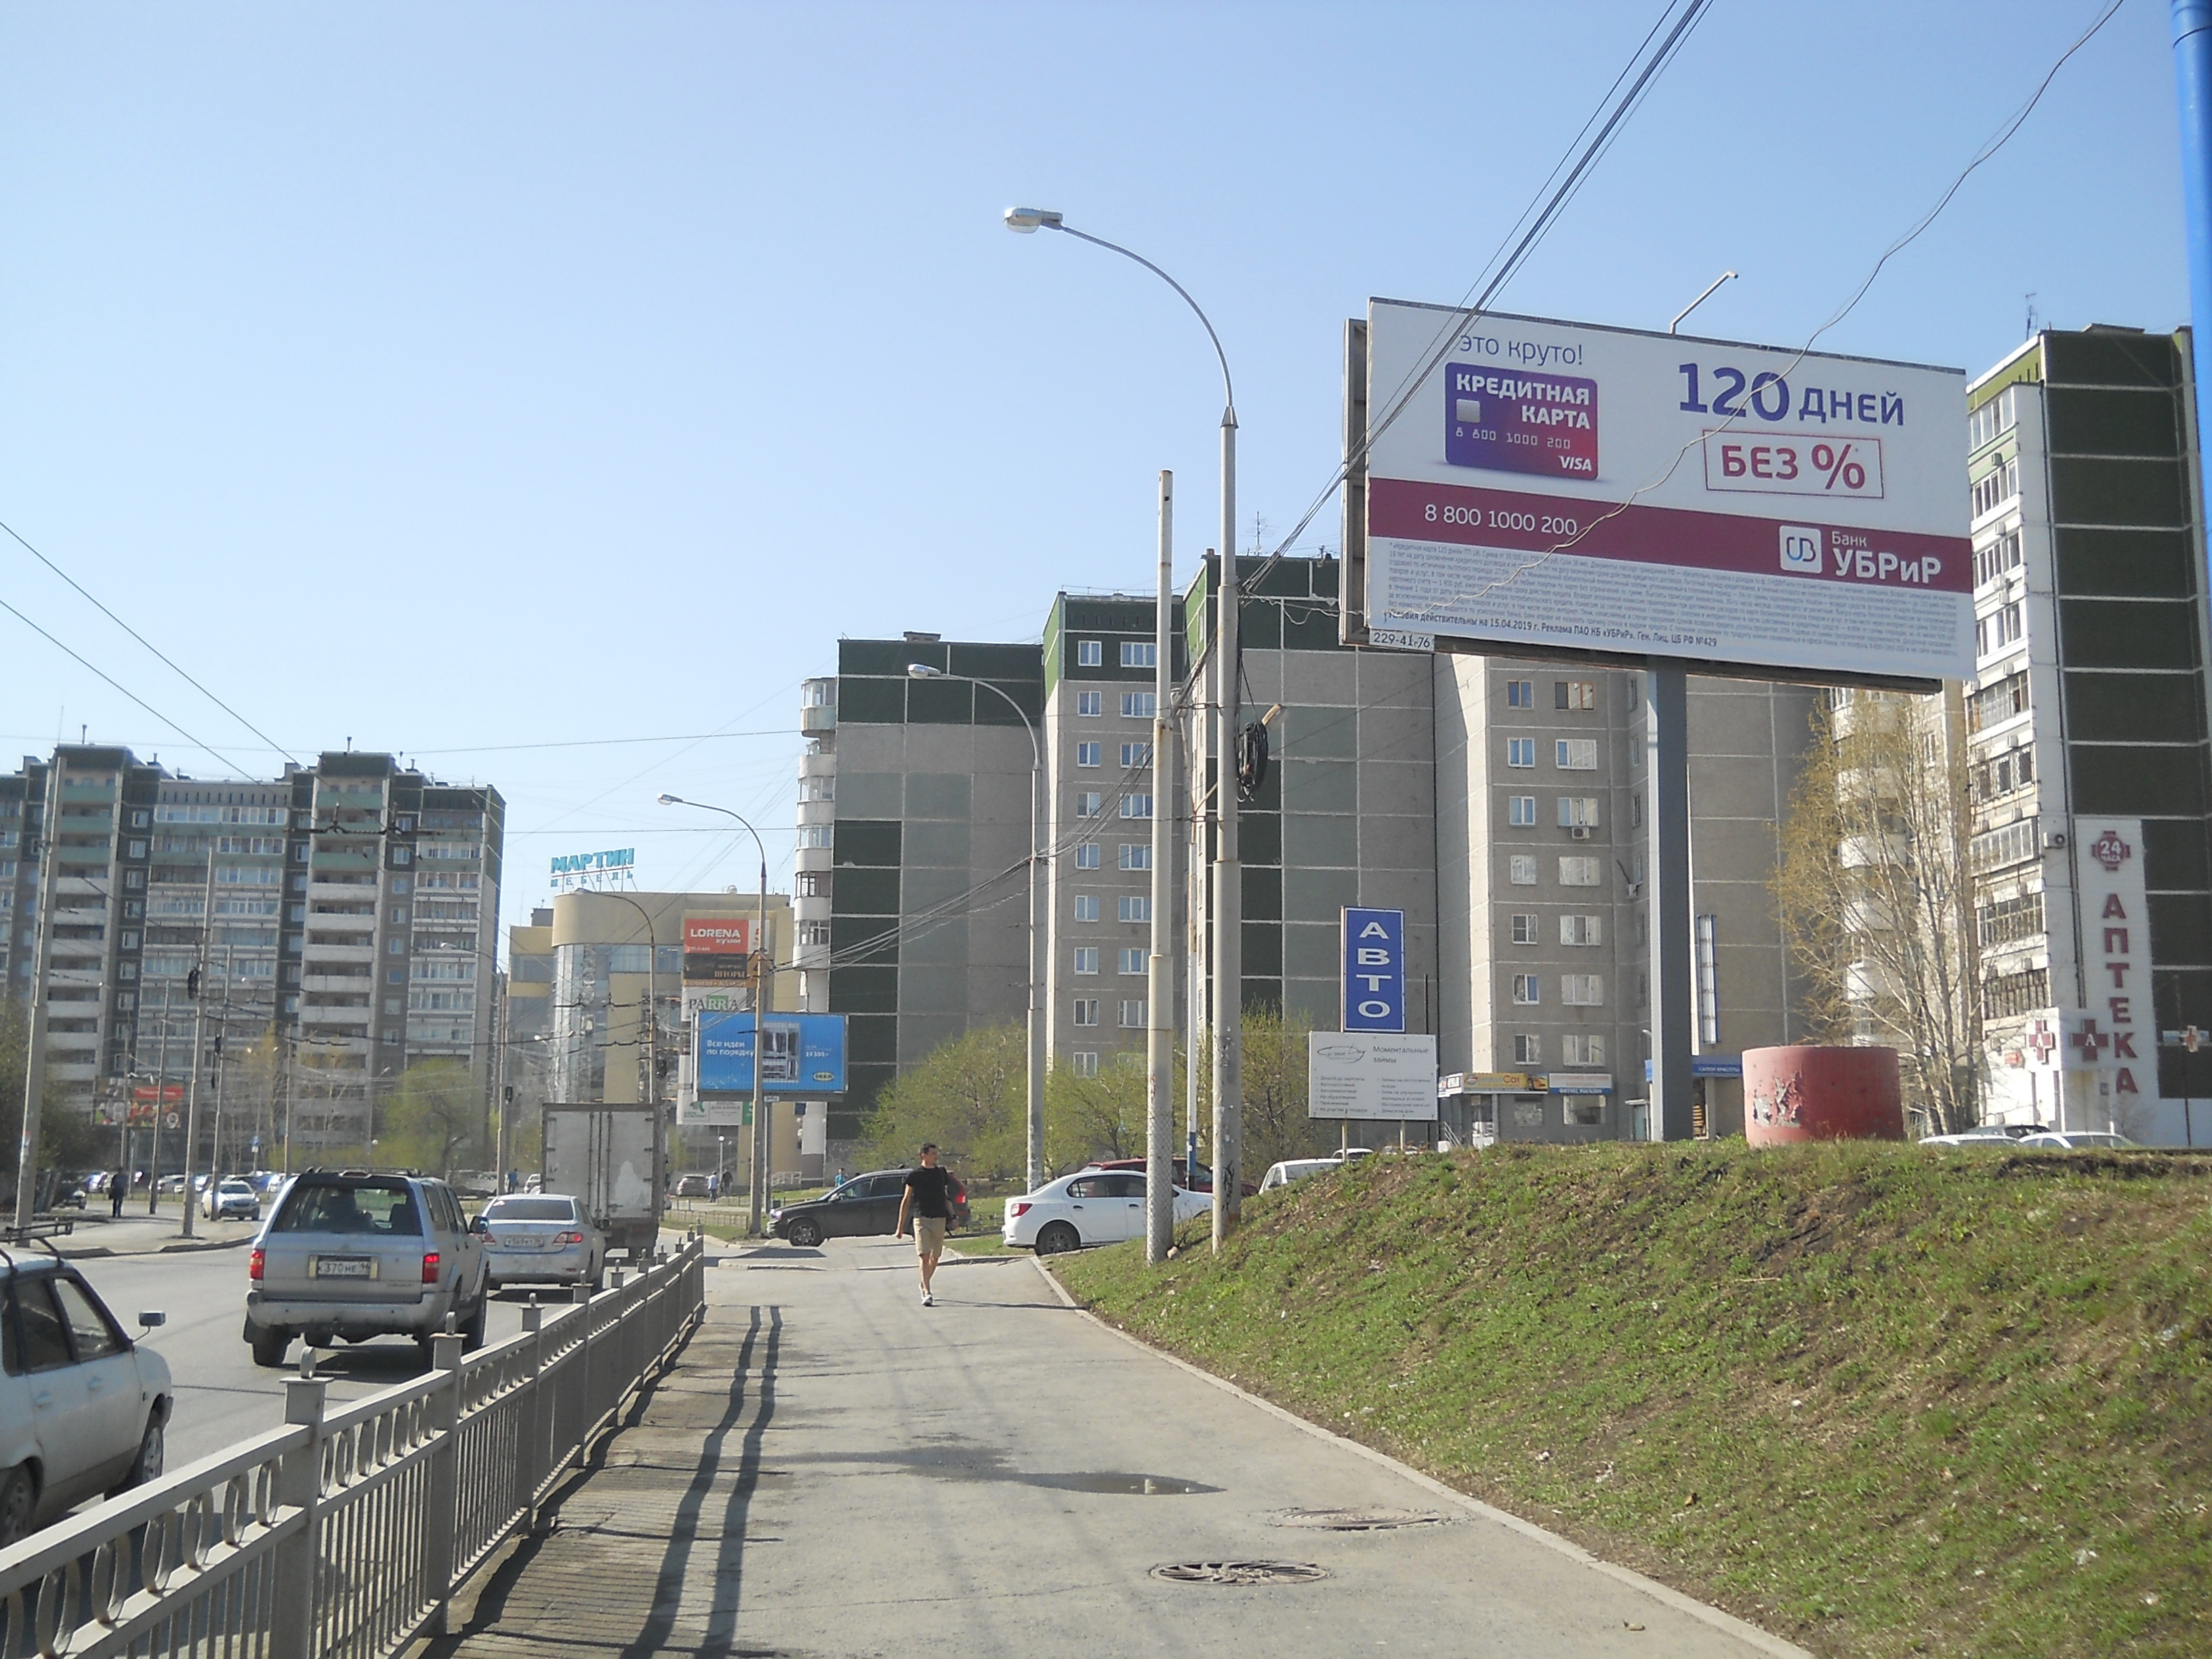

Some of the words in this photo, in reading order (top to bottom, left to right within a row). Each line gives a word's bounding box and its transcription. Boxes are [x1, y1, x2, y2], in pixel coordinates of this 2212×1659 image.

[1459, 334, 1500, 355] это
[1508, 340, 1583, 367] круто!
[1456, 373, 1590, 406] КРЕДИТНАЯ
[1678, 363, 1790, 422] 120
[1799, 387, 1904, 426] ДНЕЙ
[1521, 405, 1591, 430] КАРТА
[1506, 432, 1538, 446] 1000
[1547, 437, 1571, 450] 200
[1558, 455, 1593, 472] VISA
[1721, 445, 1799, 480] БЕЗ
[1425, 504, 1437, 522] 8
[1443, 506, 1481, 526] 800
[1488, 510, 1536, 531] 1000
[1541, 516, 1578, 536] 200
[1831, 531, 1867, 548] Банк
[1832, 548, 1942, 584] УБРиР
[1420, 611, 1477, 626] действительны
[1479, 619, 1488, 627] на
[1490, 619, 1532, 631] 15.04.2019
[1541, 623, 1572, 634] Реклама
[1574, 625, 1589, 636] ПАО
[1591, 626, 1601, 637] КБ
[1637, 630, 1652, 641] Ген.
[1671, 633, 1682, 644] ЦБ
[1683, 634, 1694, 644] РФ
[1696, 636, 1717, 647] №429
[1373, 632, 1431, 649] 229-41-76
[2100, 840, 2122, 855] 24
[550, 847, 635, 874] МАРТИН
[550, 870, 634, 888] МЕБЕЛЬ
[690, 928, 741, 938] LORENA
[1355, 920, 1393, 1019] АВТО
[2102, 893, 2139, 1095] АПТЕКА
[689, 998, 738, 1010] PARRA
[706, 1040, 722, 1048] Все
[1372, 1046, 1429, 1054] Моментальные
[719, 1050, 754, 1058] порядку
[1502, 1075, 1520, 1084] Car
